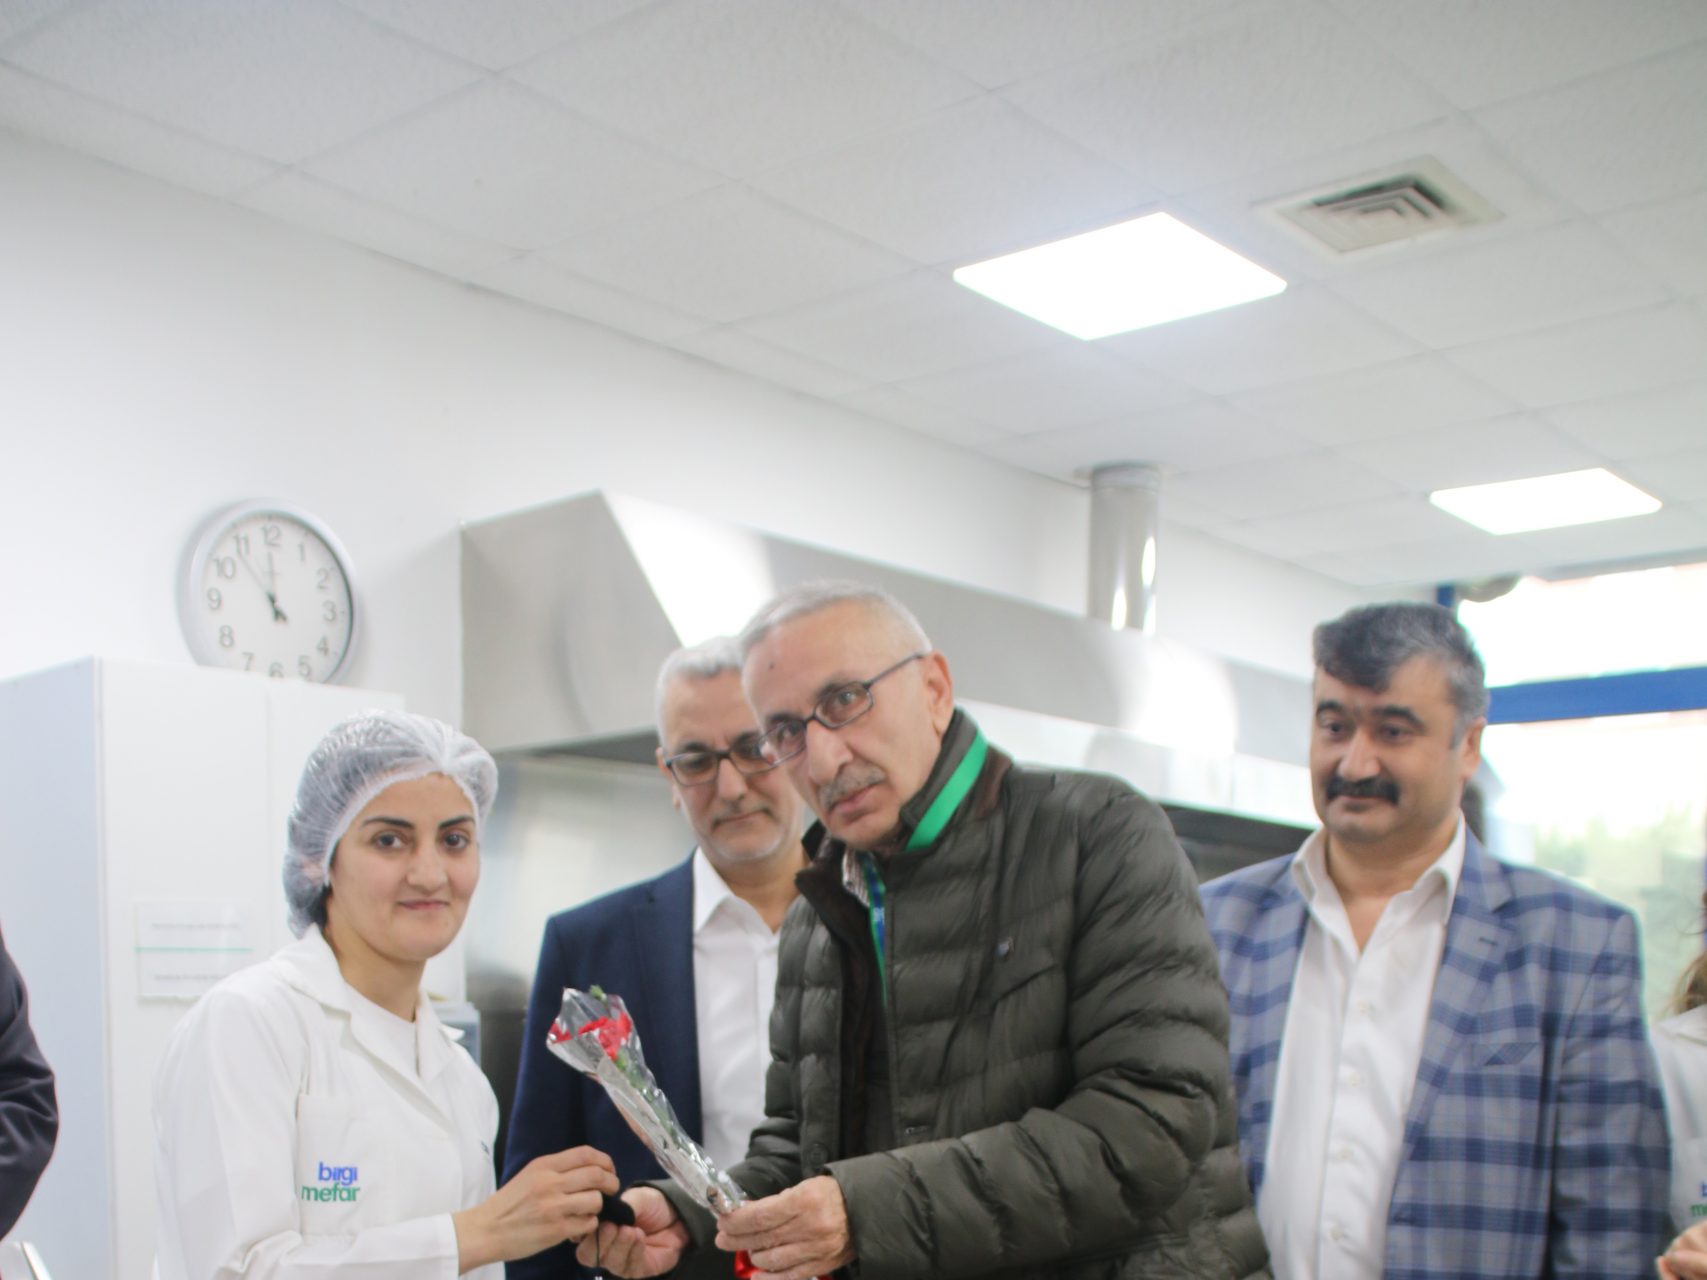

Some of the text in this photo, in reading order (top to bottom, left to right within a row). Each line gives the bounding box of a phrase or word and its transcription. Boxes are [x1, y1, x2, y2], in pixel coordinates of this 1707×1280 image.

[234, 533, 250, 556] 11
[261, 524, 281, 547] 12
[297, 541, 306, 562] 1
[213, 556, 236, 580] 10
[316, 566, 330, 590] 2
[206, 586, 222, 611] 9
[322, 599, 337, 623] 3
[218, 624, 234, 648] 8
[315, 635, 329, 656] 4
[241, 651, 255, 672] 7
[297, 655, 312, 678] 5
[301, 1182, 361, 1202] mefar
